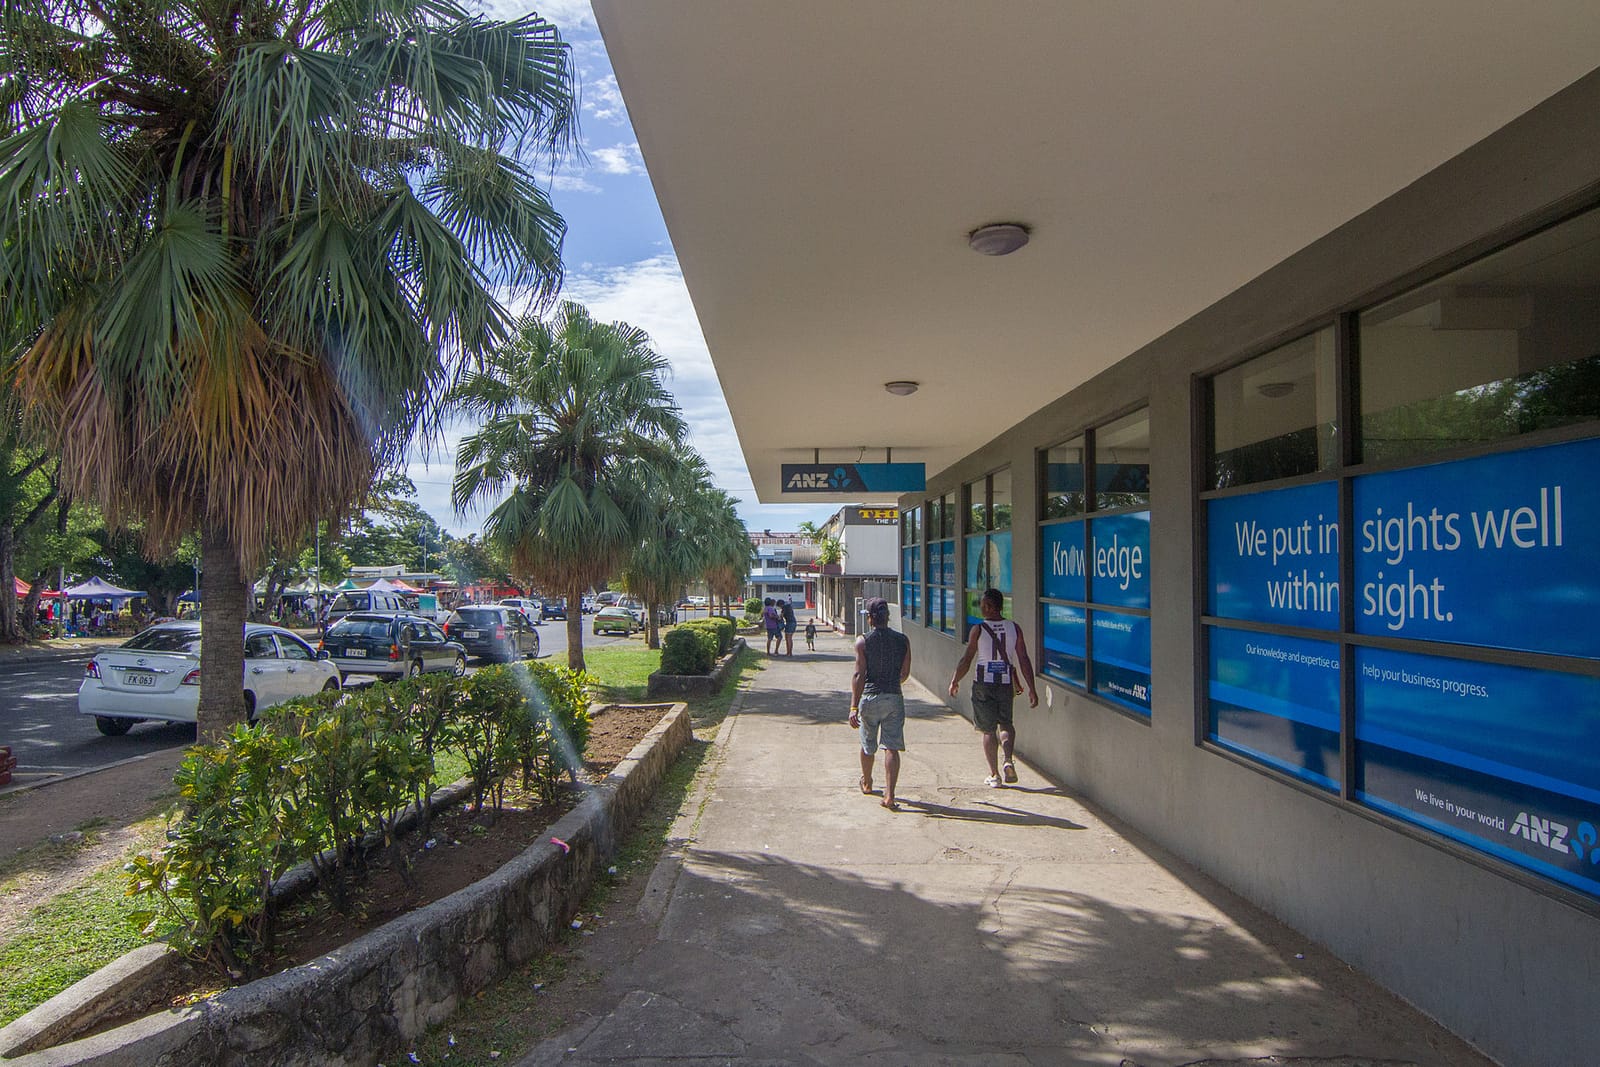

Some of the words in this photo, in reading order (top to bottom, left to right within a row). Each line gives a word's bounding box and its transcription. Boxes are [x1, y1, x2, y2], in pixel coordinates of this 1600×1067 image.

[787, 473, 829, 488] ANZ
[1235, 520, 1267, 556] We
[1273, 520, 1312, 566] put
[1471, 486, 1563, 549] well
[1267, 569, 1339, 612] within
[1363, 569, 1454, 631] sight.
[1245, 643, 1257, 655] Our
[1257, 645, 1288, 662] knowledge
[1288, 651, 1300, 663] and
[1300, 654, 1330, 668] expertise
[1331, 659, 1340, 670] ca
[1362, 662, 1380, 680] help
[1381, 668, 1400, 682] your
[1401, 669, 1441, 689] business
[1442, 679, 1489, 698] progress.
[1415, 788, 1429, 803] We
[1429, 793, 1444, 809] live
[1445, 799, 1454, 812] in
[1455, 805, 1476, 821] your
[1477, 812, 1505, 831] world
[1509, 811, 1569, 854] ANZ
